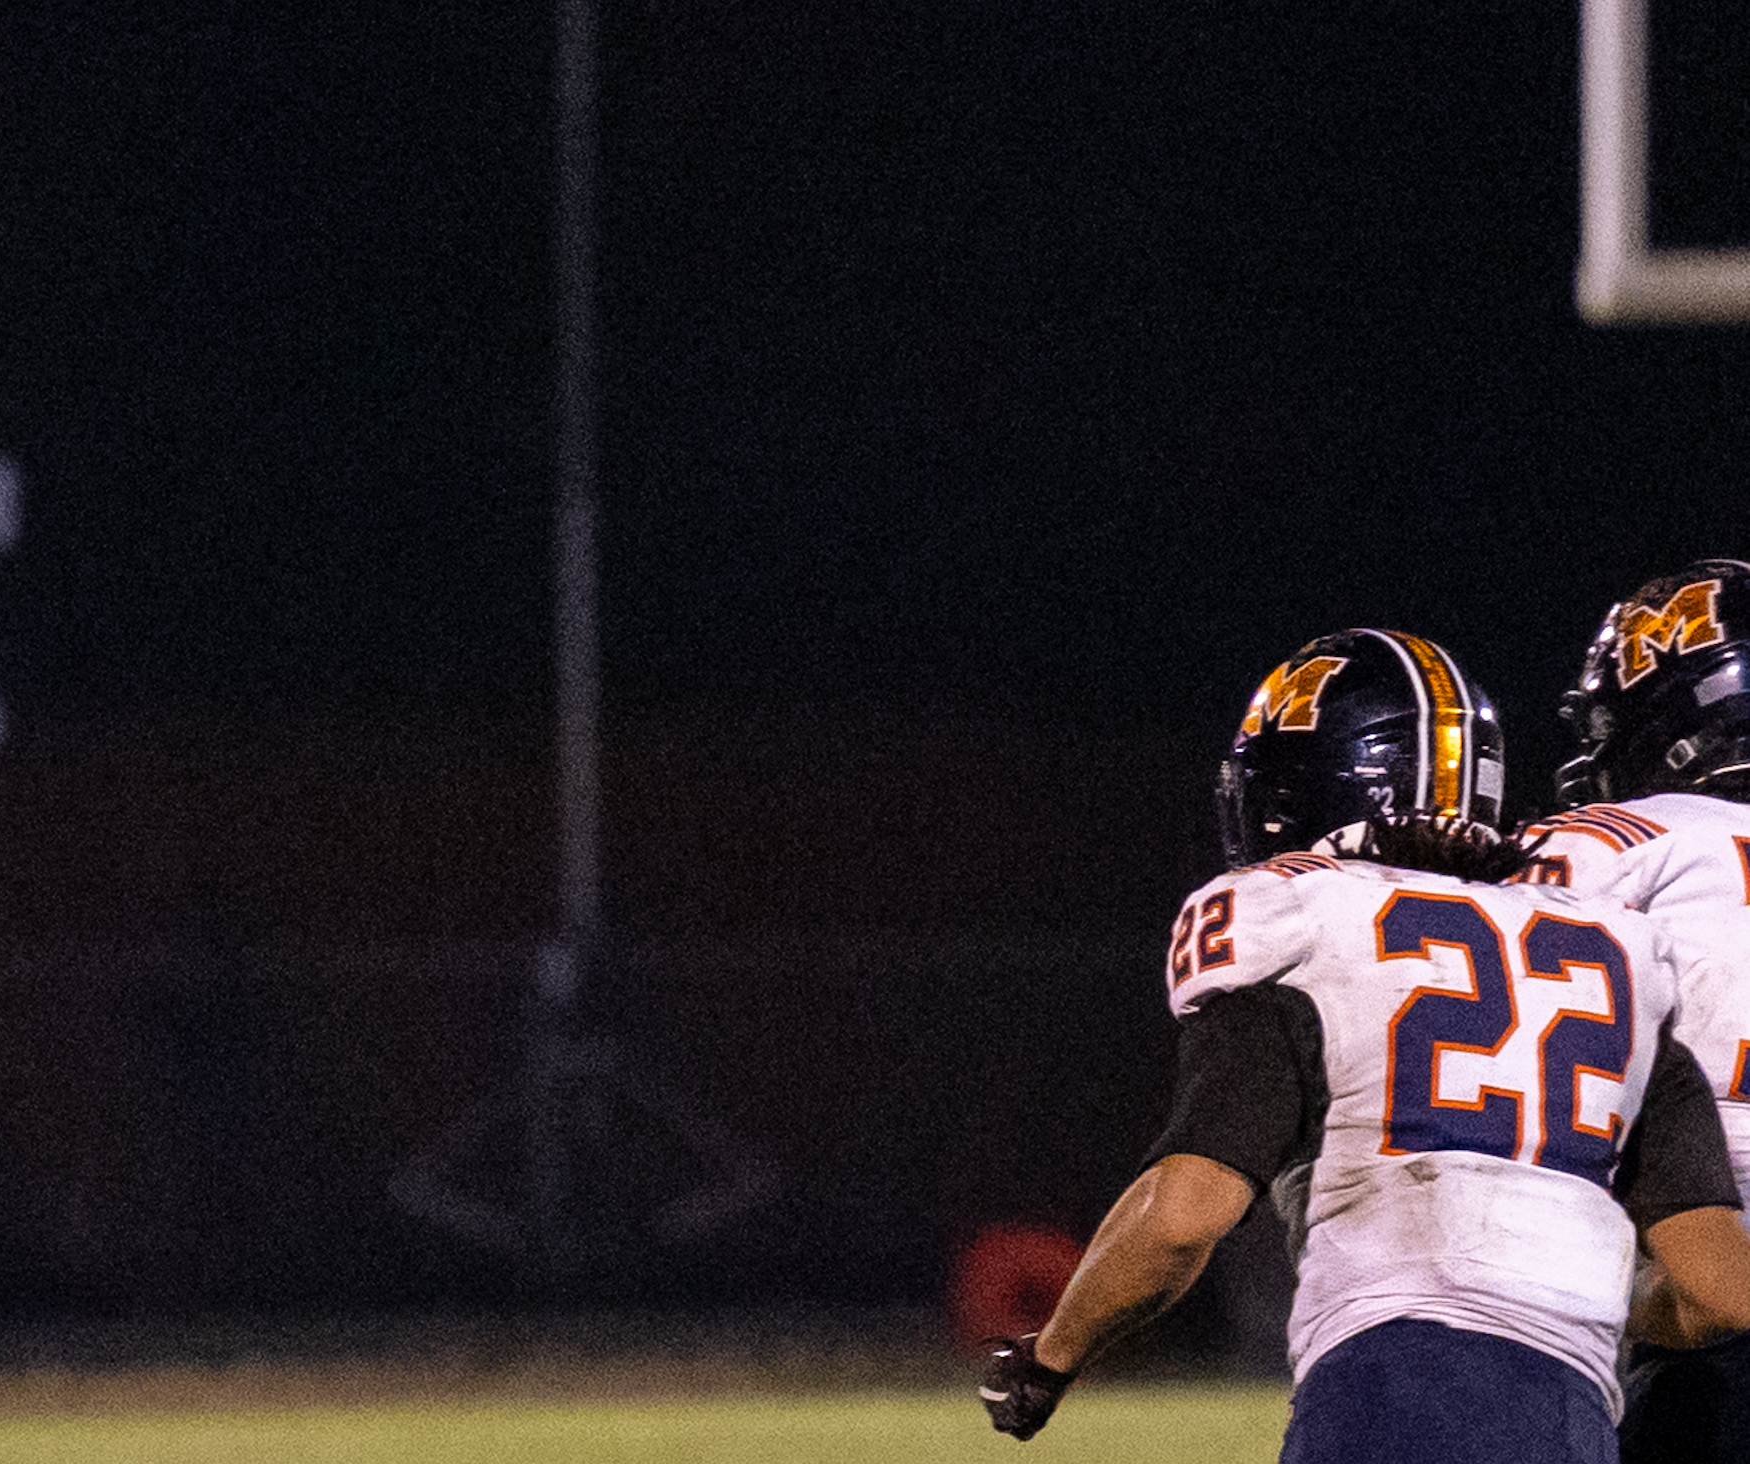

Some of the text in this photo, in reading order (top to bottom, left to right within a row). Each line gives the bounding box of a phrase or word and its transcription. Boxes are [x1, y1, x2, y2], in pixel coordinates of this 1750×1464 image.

[1617, 578, 1725, 690] M
[1240, 655, 1349, 737] M
[1173, 888, 1236, 991] 22
[1374, 889, 1635, 1196] 22
